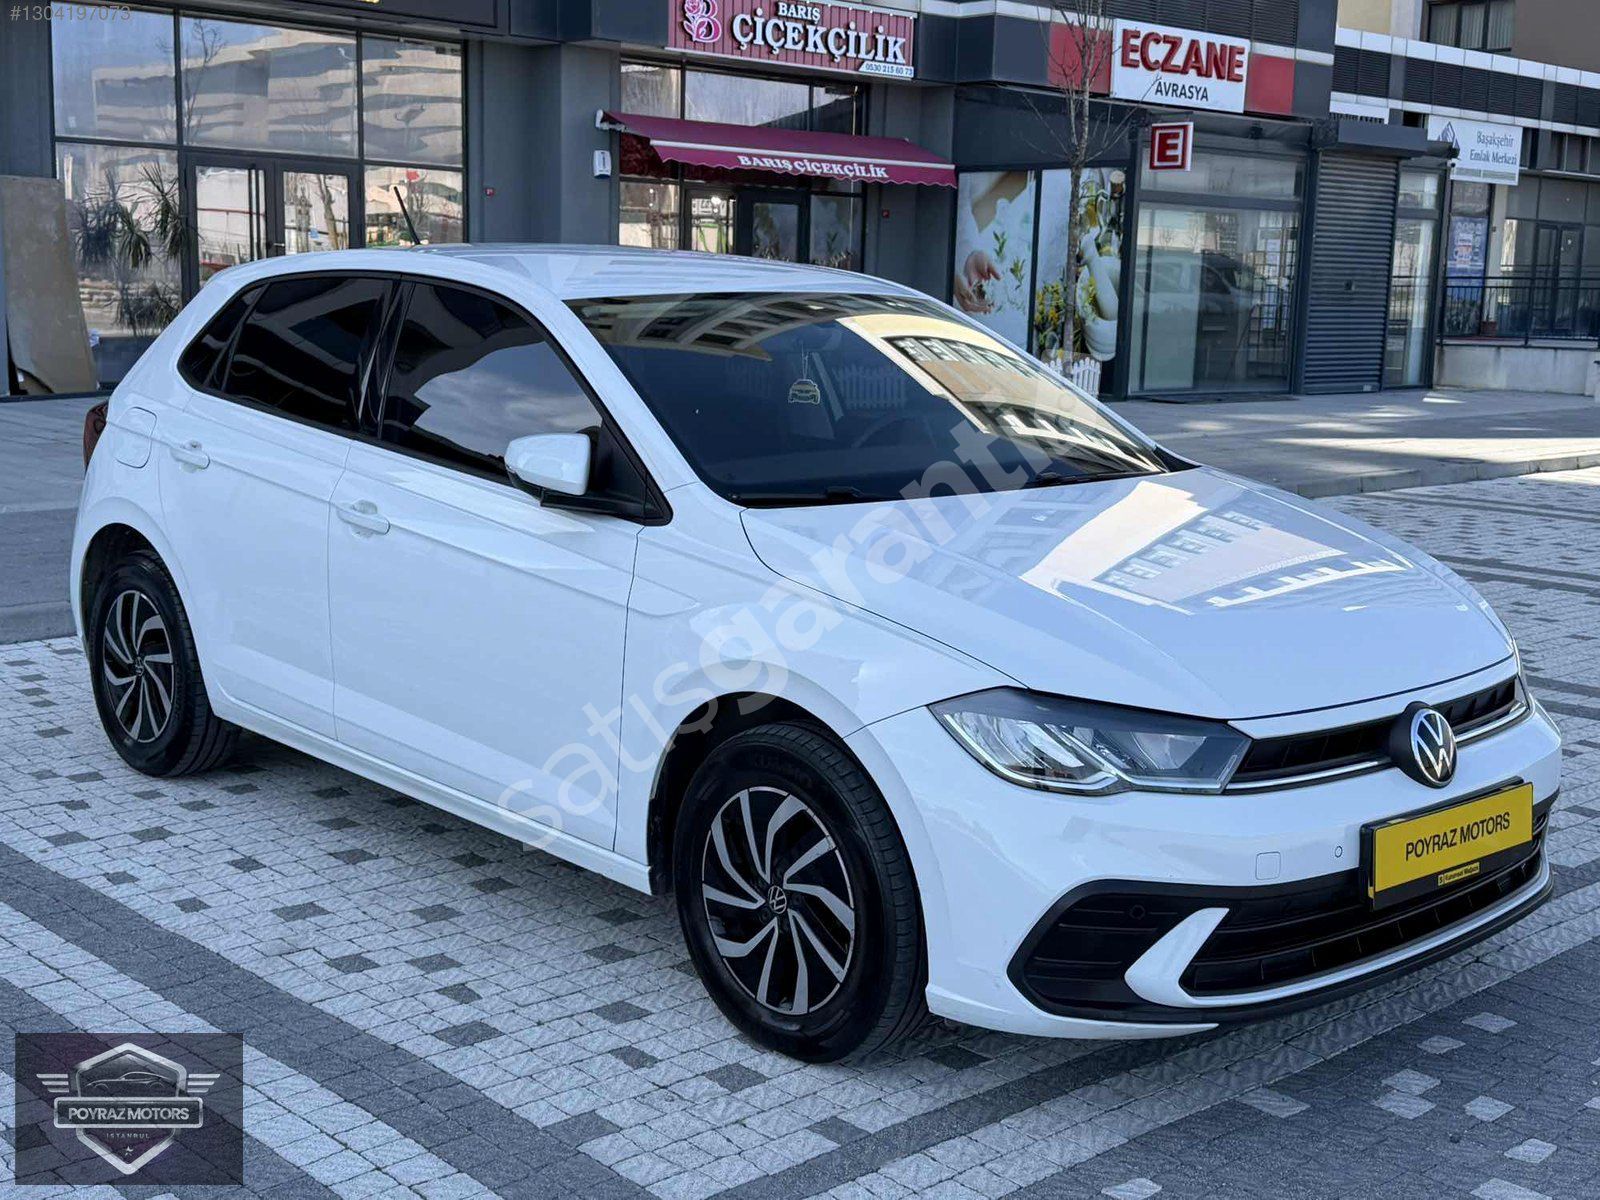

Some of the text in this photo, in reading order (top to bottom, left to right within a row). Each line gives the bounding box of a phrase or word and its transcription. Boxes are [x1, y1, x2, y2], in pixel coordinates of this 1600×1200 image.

[777, 2, 821, 25] BARIŞ
[732, 7, 907, 64] ÇİÇEKÇİLİK
[1121, 28, 1245, 83] ECZANE
[865, 63, 882, 72] 0530
[882, 64, 895, 74] 215
[1155, 81, 1209, 101] AVRASYA
[1157, 131, 1180, 163] E
[1476, 131, 1514, 149] Başakşehir
[737, 155, 889, 178] BARIŞ ÇİÇEKÇİLİK
[1470, 149, 1517, 166] Emlak Merkezi
[1406, 812, 1511, 861] POYRAZ MOTORS
